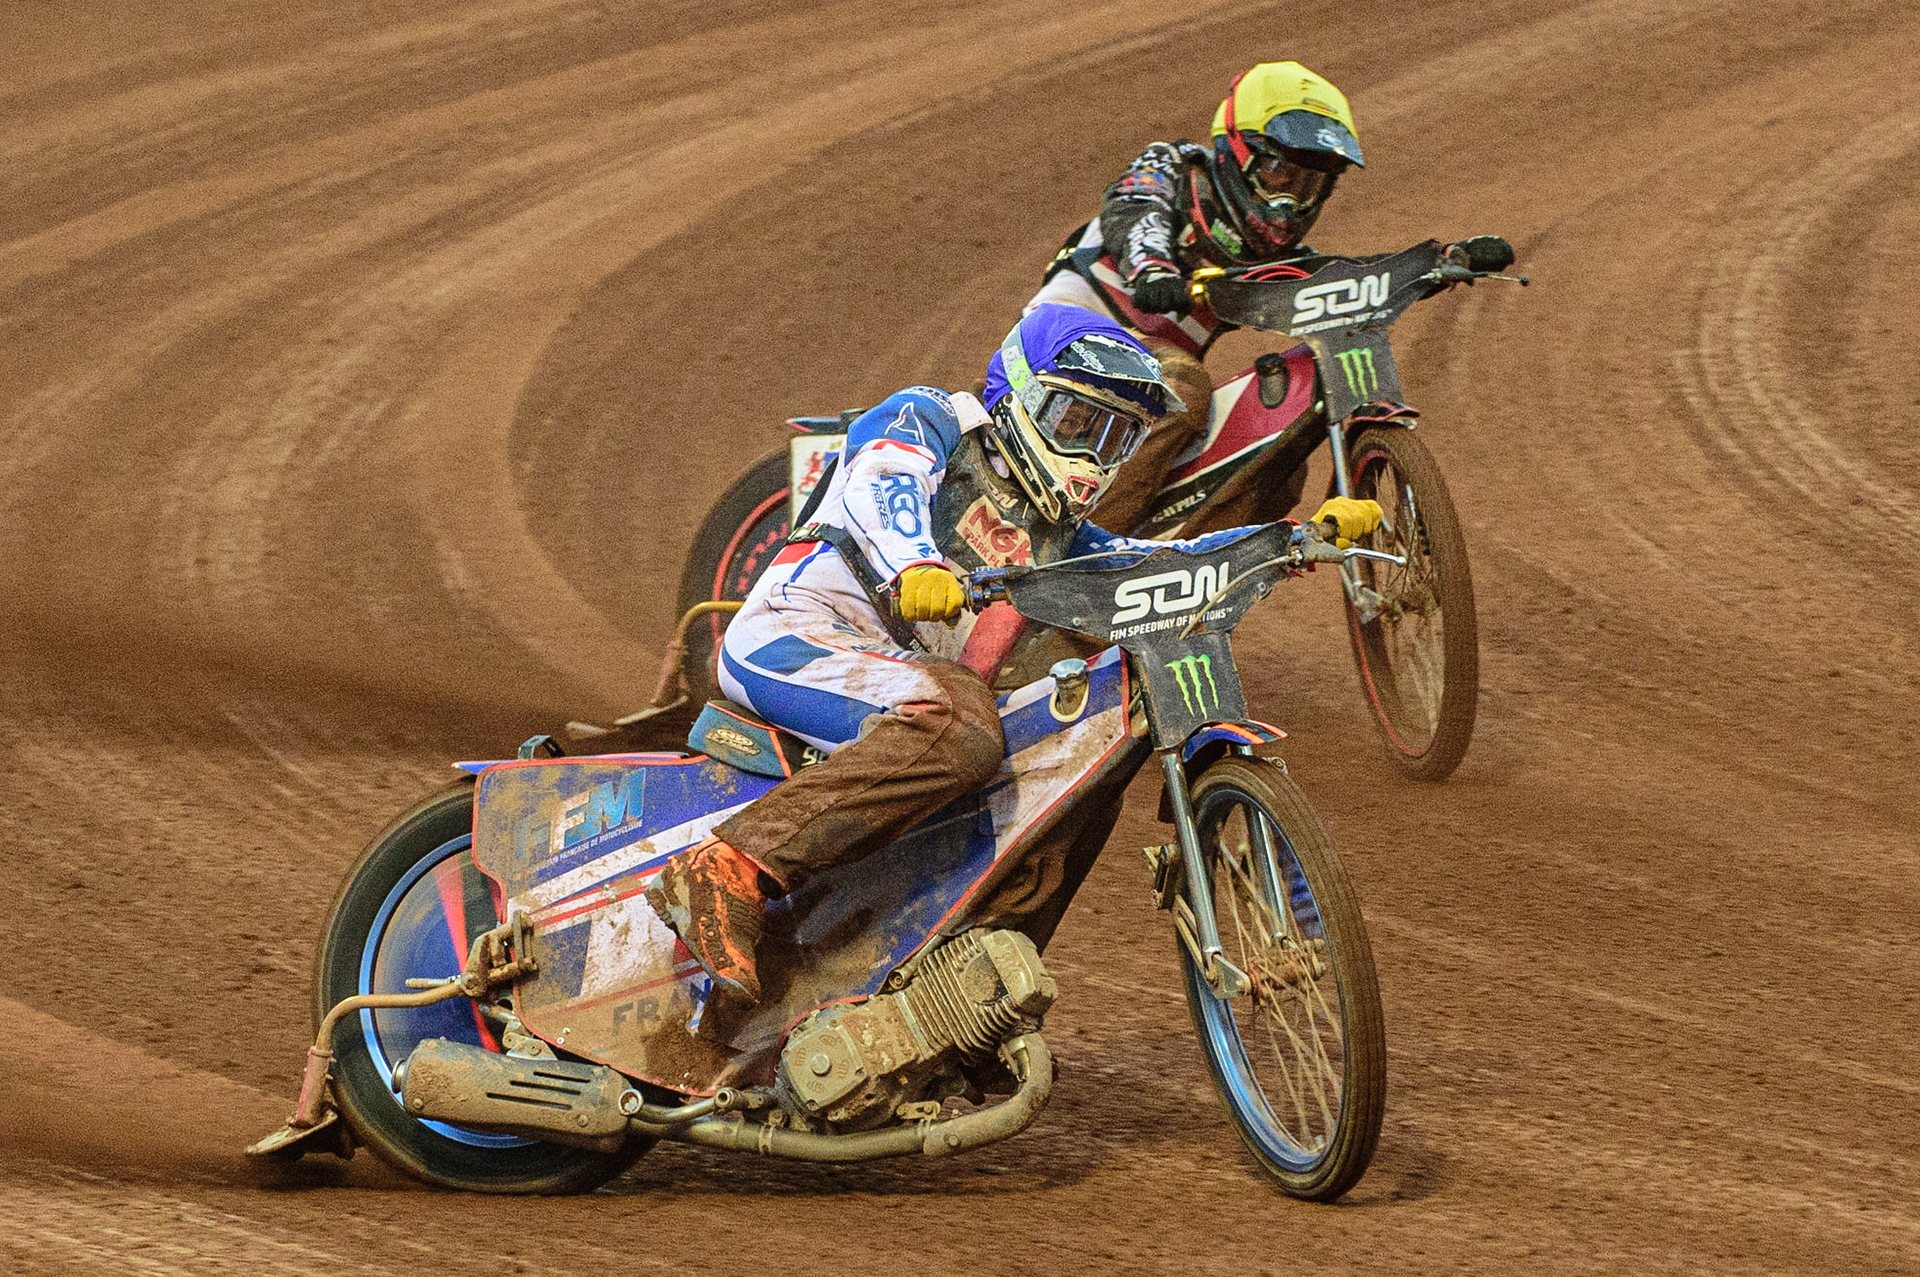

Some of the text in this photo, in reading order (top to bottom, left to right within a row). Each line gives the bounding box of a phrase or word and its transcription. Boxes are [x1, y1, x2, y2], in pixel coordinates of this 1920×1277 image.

[1292, 272, 1391, 324] SON
[962, 526, 990, 558] SPARK
[969, 504, 1032, 567] NGK
[1111, 561, 1230, 625] SON
[1110, 627, 1127, 641] FIM
[1127, 618, 1176, 639] SPEEDWAY
[1176, 615, 1189, 627] OF
